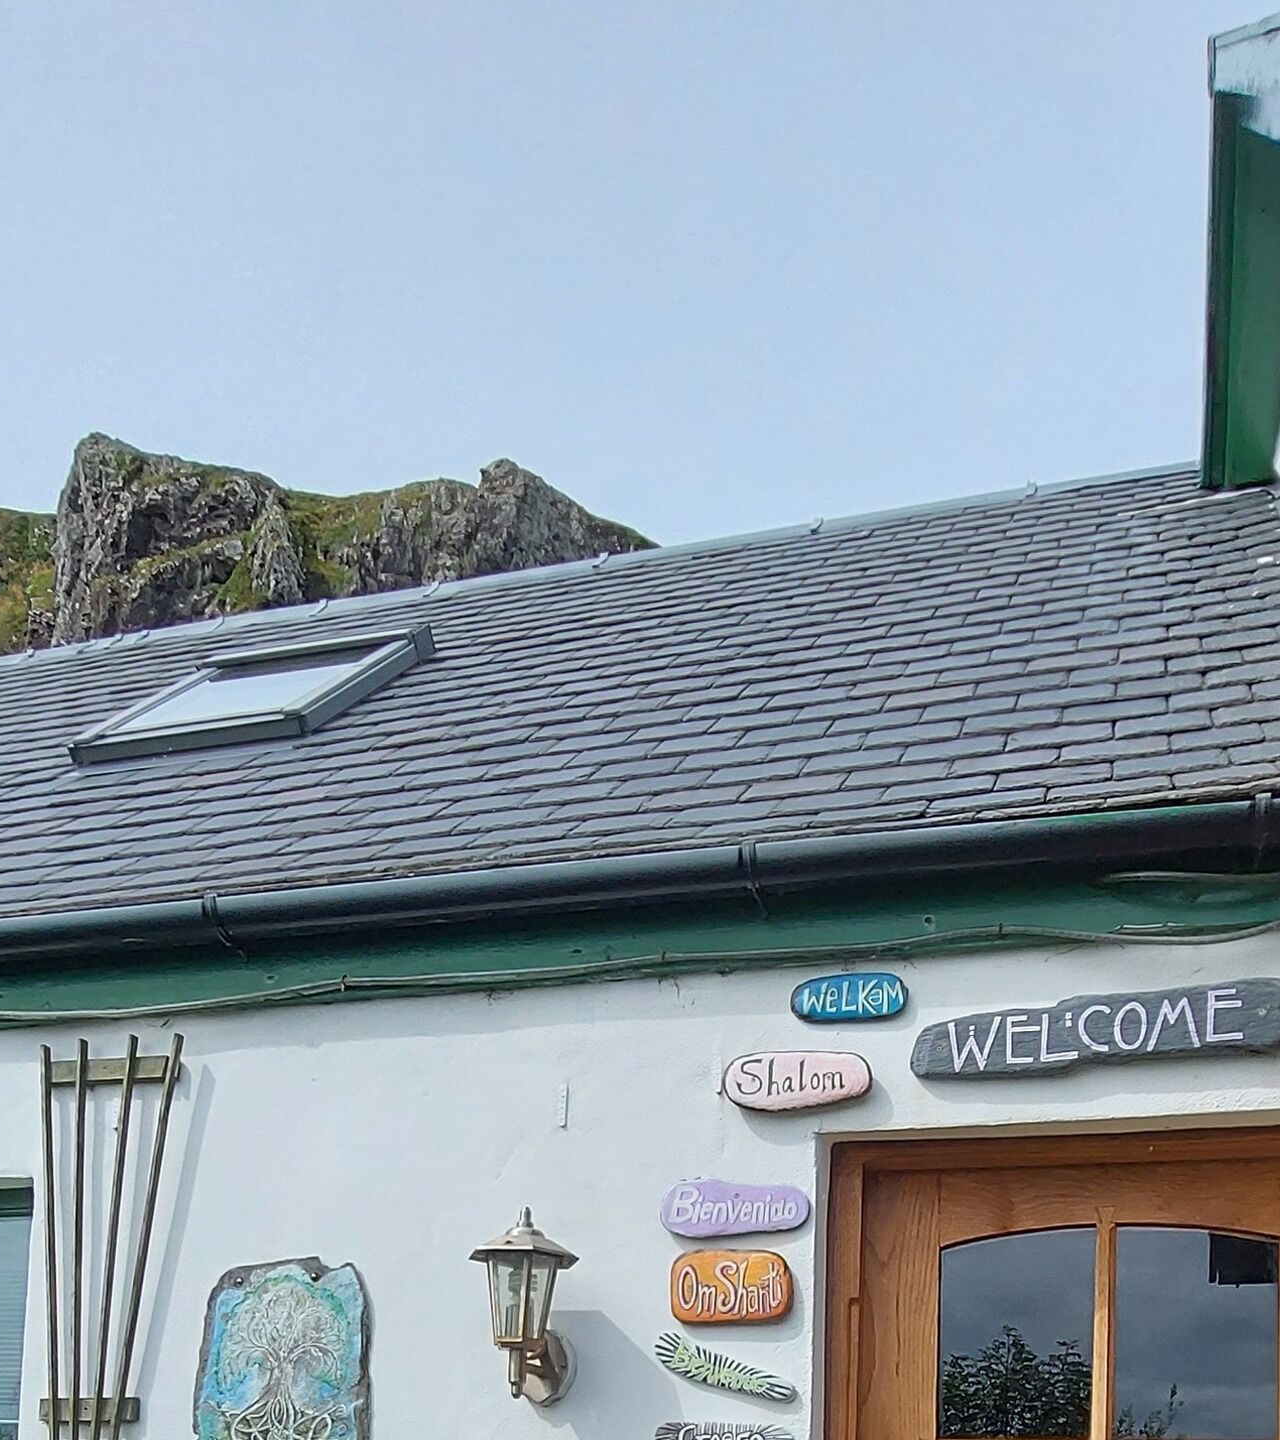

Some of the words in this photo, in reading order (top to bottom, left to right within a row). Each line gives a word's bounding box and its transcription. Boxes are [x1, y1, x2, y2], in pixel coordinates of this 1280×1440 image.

[947, 988, 1245, 1073] WELCOME
[736, 1058, 846, 1097] Shalom
[669, 1185, 799, 1225] Bienvenido
[677, 1265, 717, 1317] Om
[715, 1260, 784, 1318] Shanti
